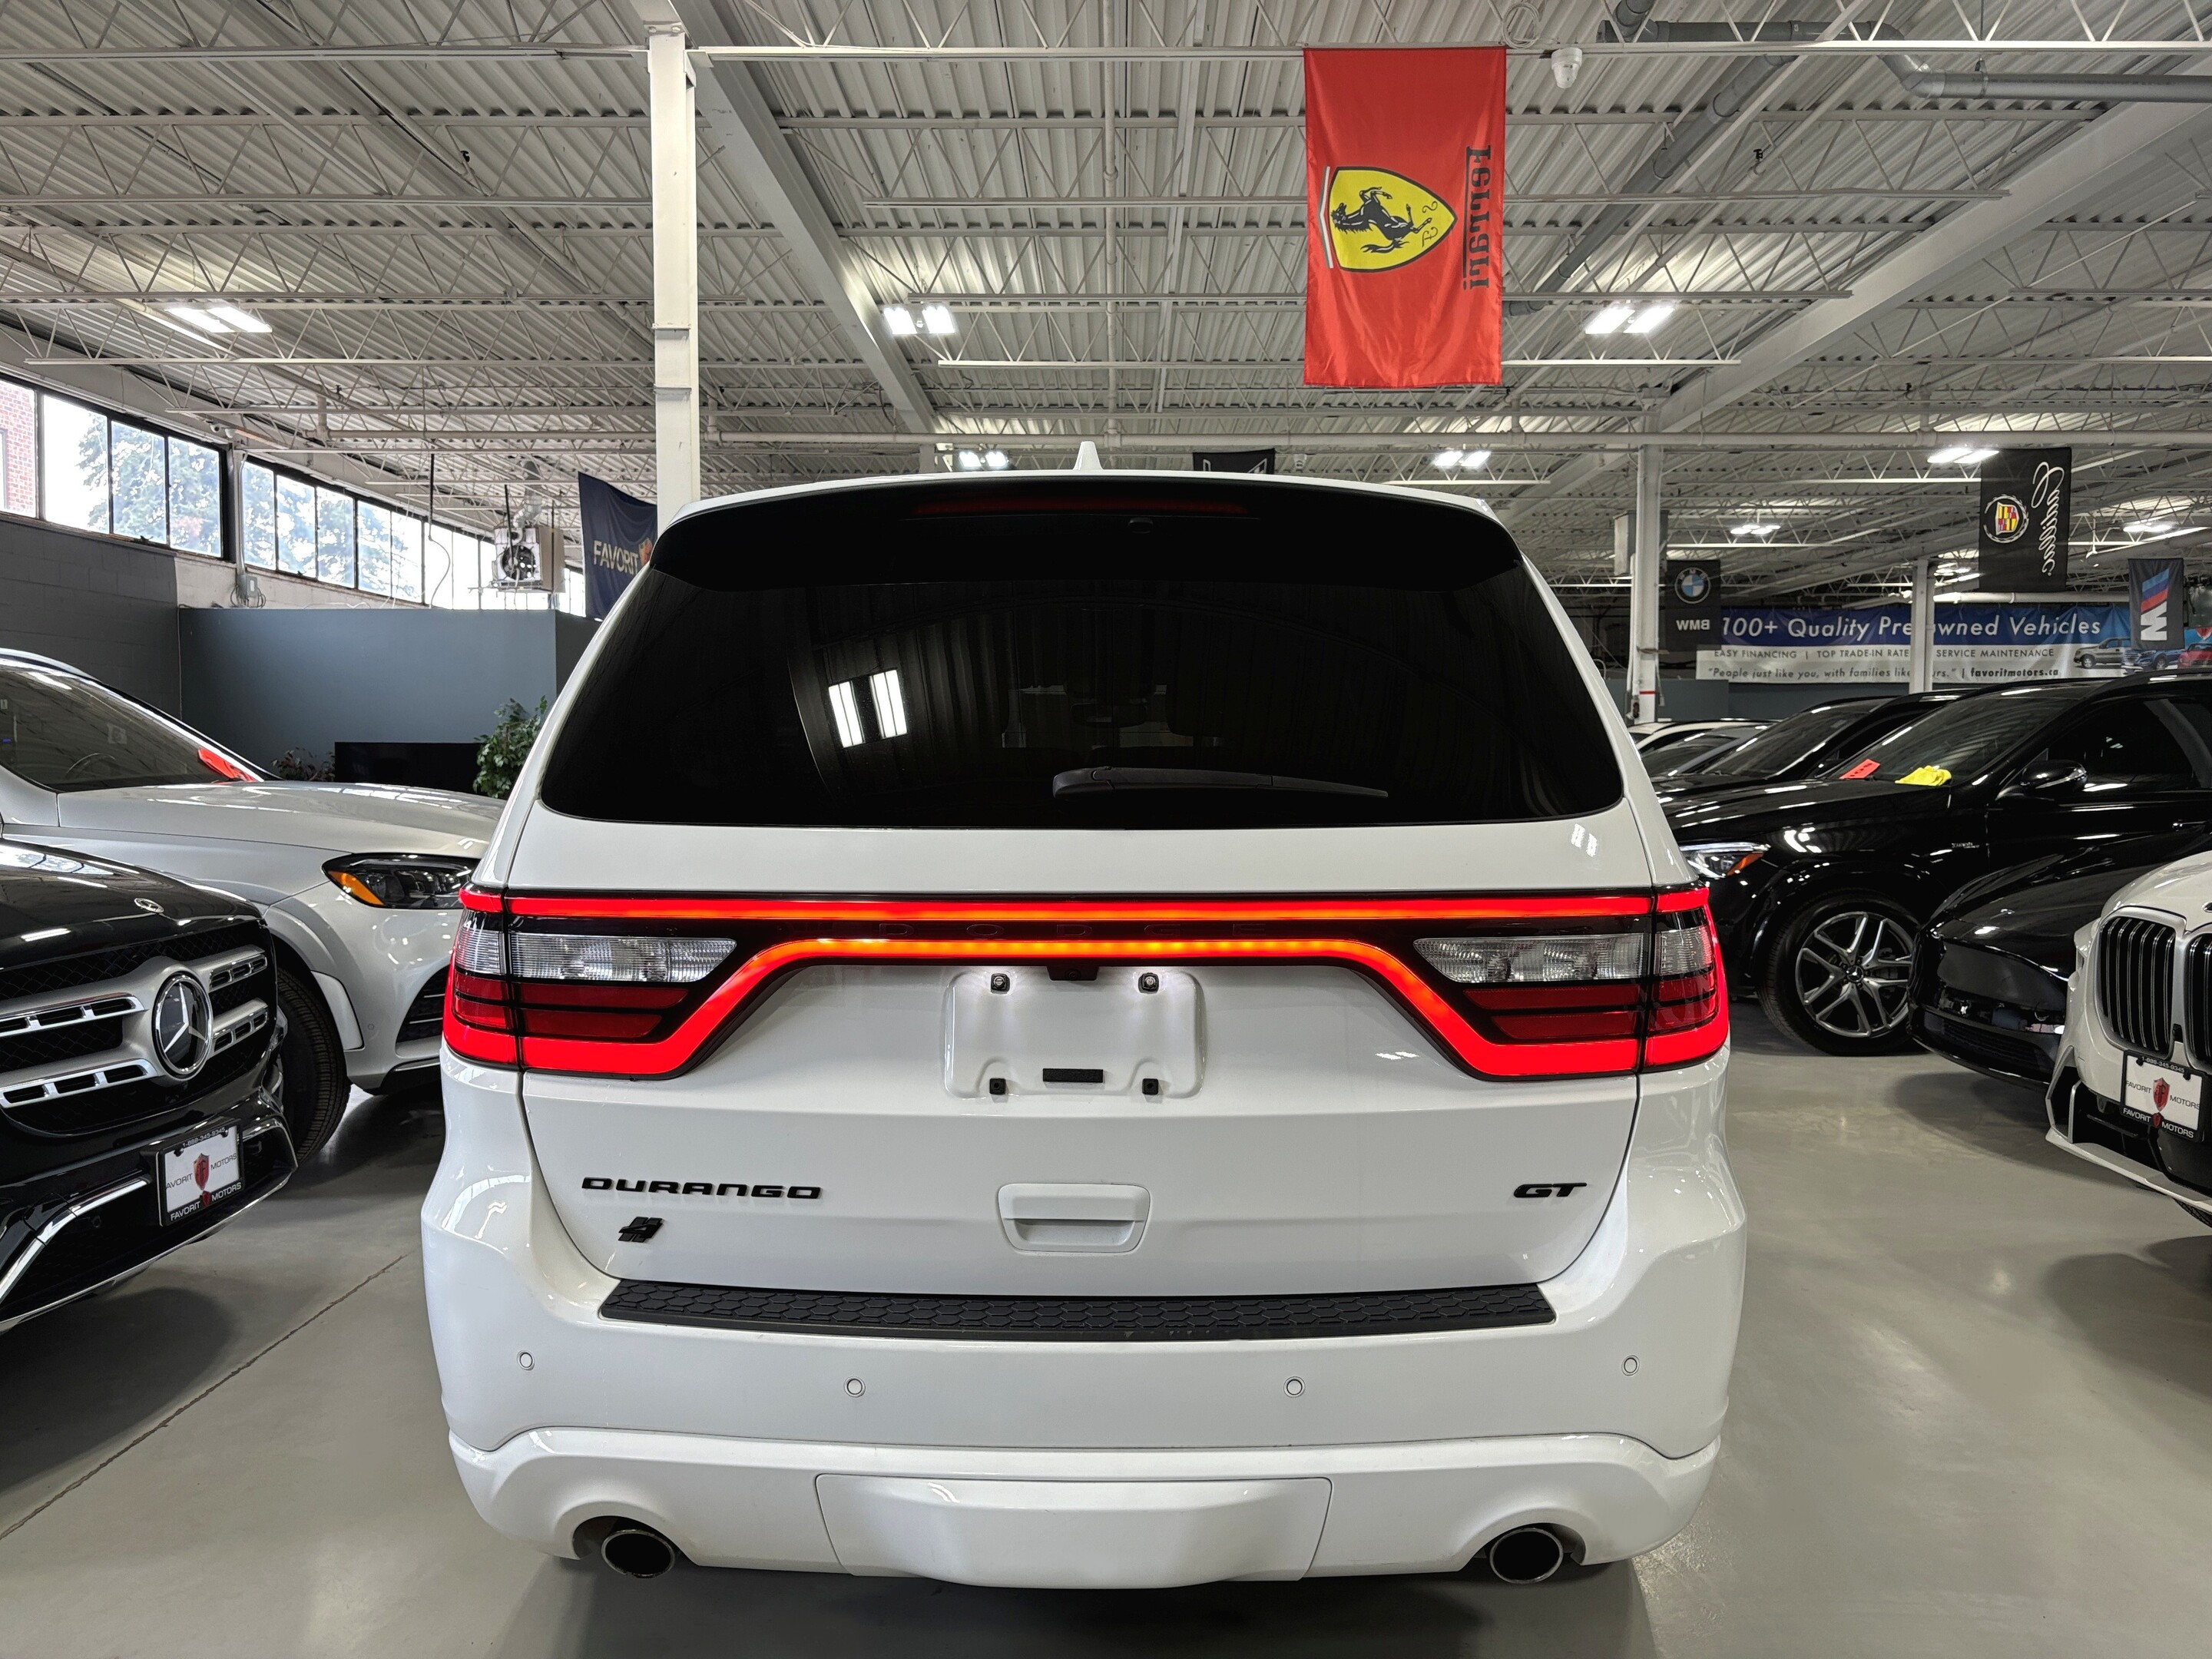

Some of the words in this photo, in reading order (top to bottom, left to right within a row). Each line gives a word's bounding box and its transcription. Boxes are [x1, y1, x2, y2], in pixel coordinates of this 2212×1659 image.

[593, 540, 639, 575] FAVORIT
[1721, 617, 1778, 637] 100+
[1787, 616, 1870, 641] Quality
[2009, 613, 2101, 636] Vehicles
[1714, 649, 1738, 657] EASY
[1741, 650, 1797, 658] FINANCING
[1817, 650, 1836, 658] TOP
[1840, 649, 1883, 658] TRADE-IN
[1936, 649, 1976, 657] SERVICE
[1980, 648, 2055, 658] MAINTENANCE
[1752, 668, 1772, 678] just
[1775, 668, 1794, 677] like
[1797, 670, 1820, 680] you,
[1824, 667, 1846, 677] with
[1849, 667, 1891, 677] families
[1970, 667, 2059, 677] favoritmotors.ca
[879, 923, 1267, 936] DODGE
[2125, 1080, 2152, 1094] FAVORIT
[2170, 1094, 2200, 1111] MOTORS
[2122, 1107, 2152, 1123] FAVORIT
[2161, 1121, 2194, 1139] MOTORS
[165, 1173, 193, 1190] AVORIT
[210, 1153, 237, 1171] MOTORS
[170, 1200, 201, 1222] FAVORIT
[211, 1181, 243, 1203] MOTORS
[581, 1177, 822, 1200] DURANGO
[1513, 1182, 1588, 1198] GT
